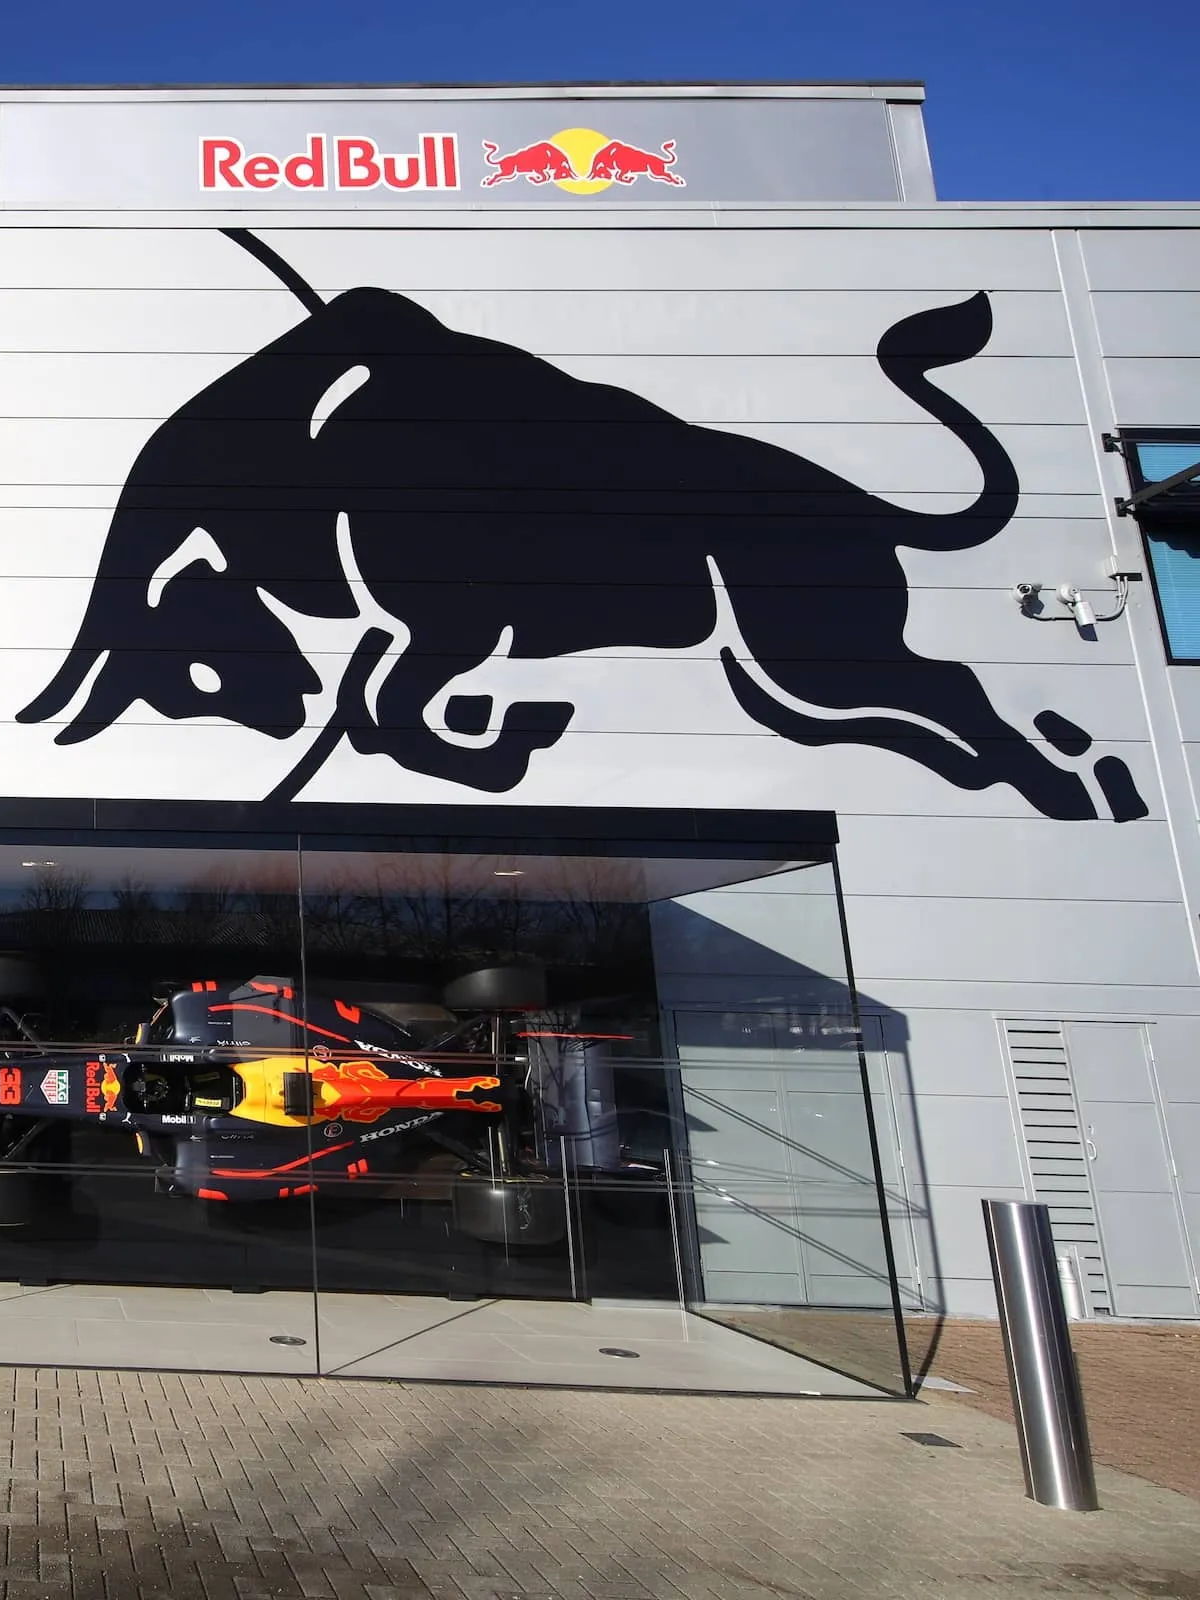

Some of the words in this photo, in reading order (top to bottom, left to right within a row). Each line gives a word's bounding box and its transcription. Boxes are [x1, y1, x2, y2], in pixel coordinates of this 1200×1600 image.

[201, 135, 326, 189] Red
[336, 134, 459, 189] Bull
[169, 1054, 194, 1062] Mobil
[43, 1071, 58, 1104] HEUER
[57, 1072, 68, 1103] TAG
[86, 1061, 100, 1087] Red
[86, 1087, 100, 1113] Bull
[161, 1114, 187, 1124] Mobil
[359, 1111, 445, 1143] HONDA
